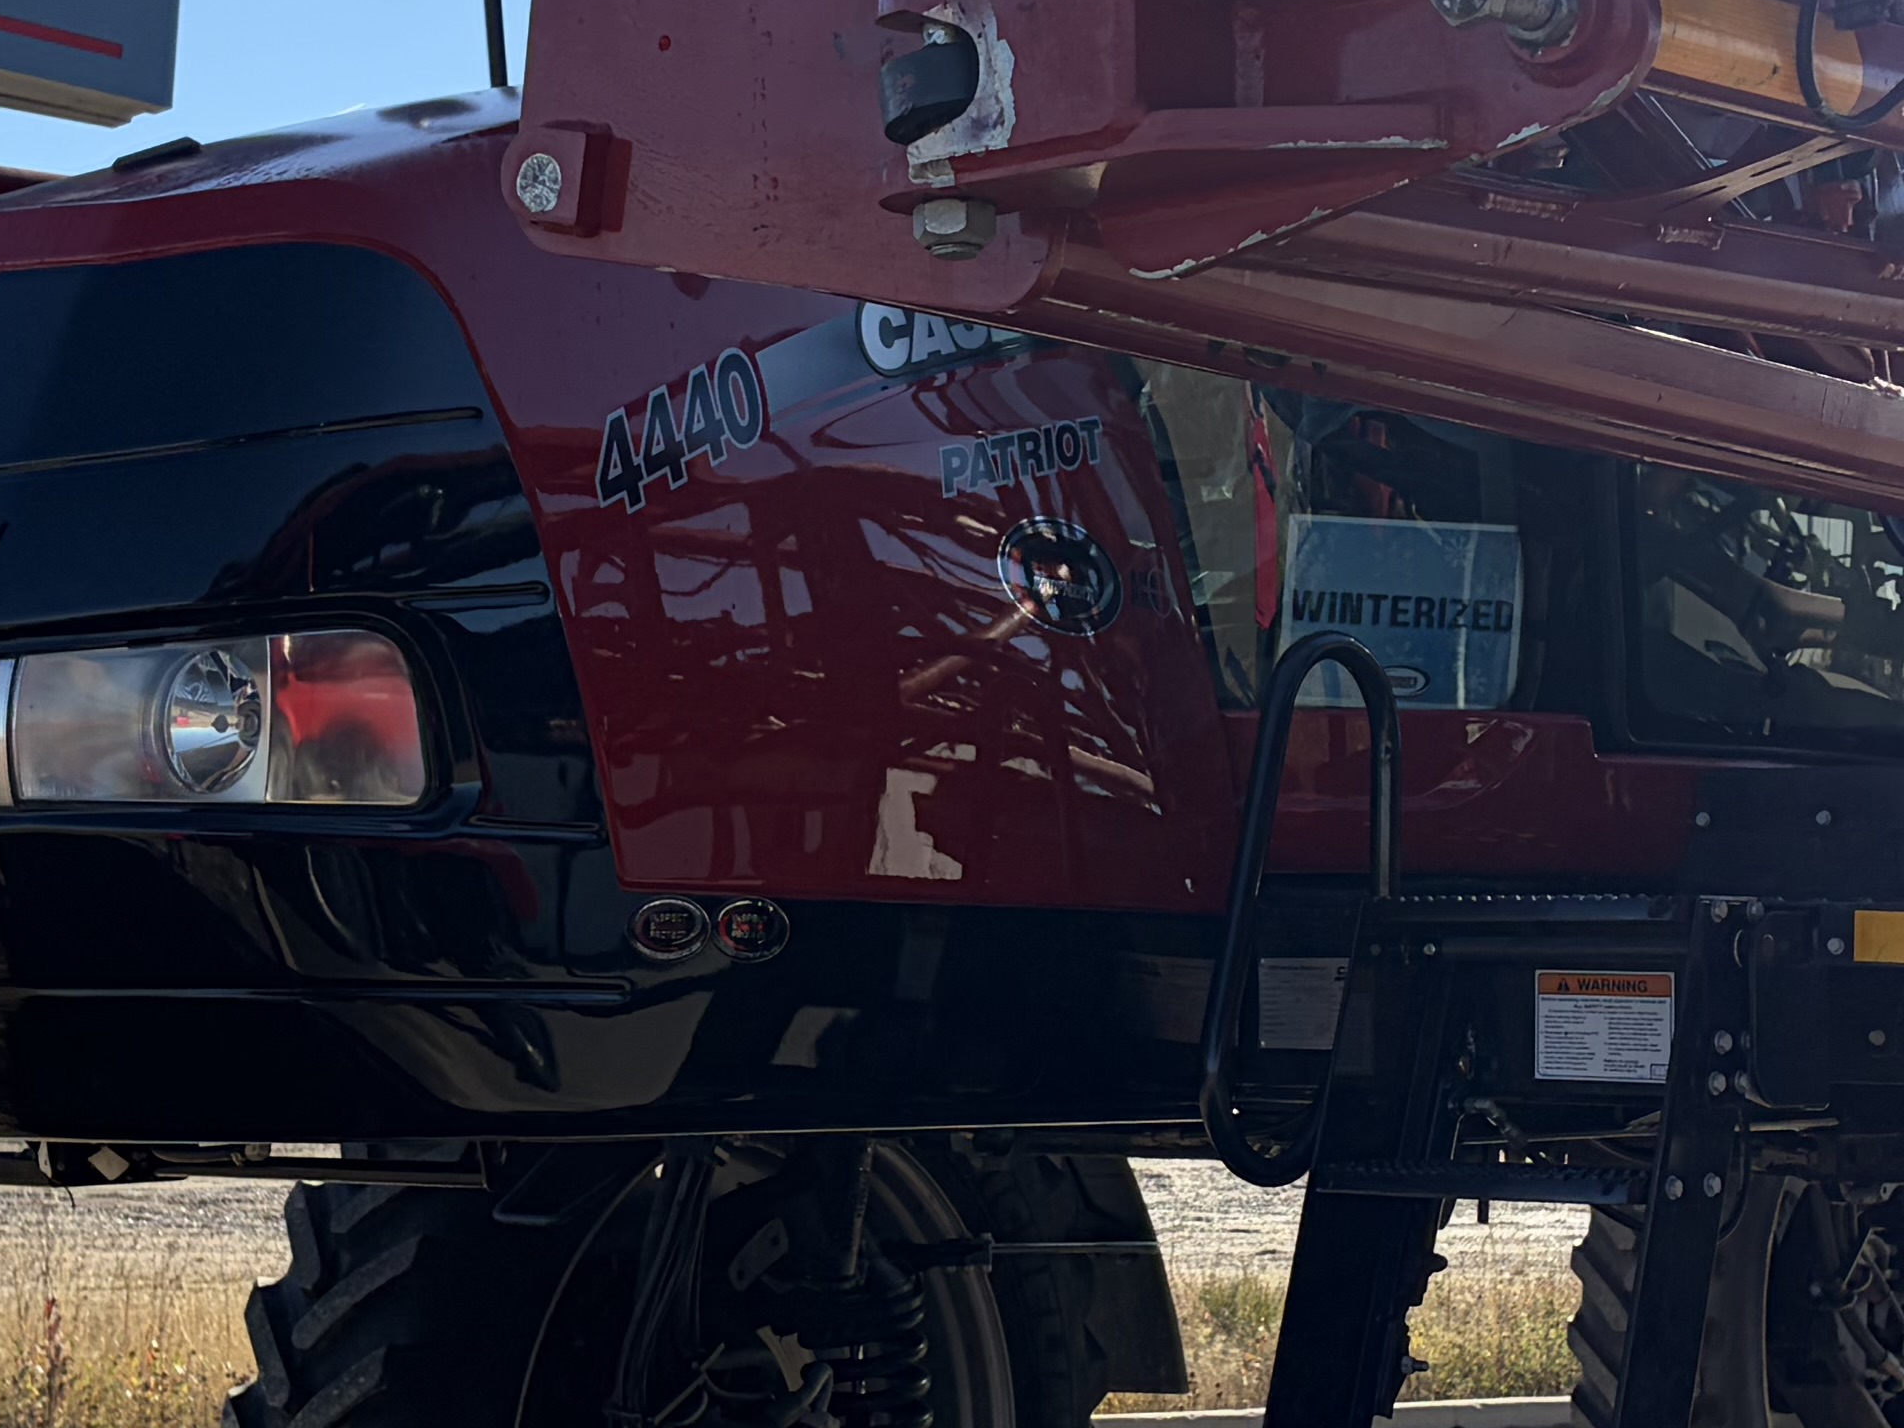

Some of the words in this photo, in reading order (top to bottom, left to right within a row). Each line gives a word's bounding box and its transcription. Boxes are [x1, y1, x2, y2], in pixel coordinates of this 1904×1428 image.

[861, 303, 1026, 372] CAS
[597, 348, 763, 515] 4440
[940, 416, 1102, 498] PATRIOT
[1291, 589, 1514, 632] WINTERIZED
[1578, 978, 1648, 993] WARNING
